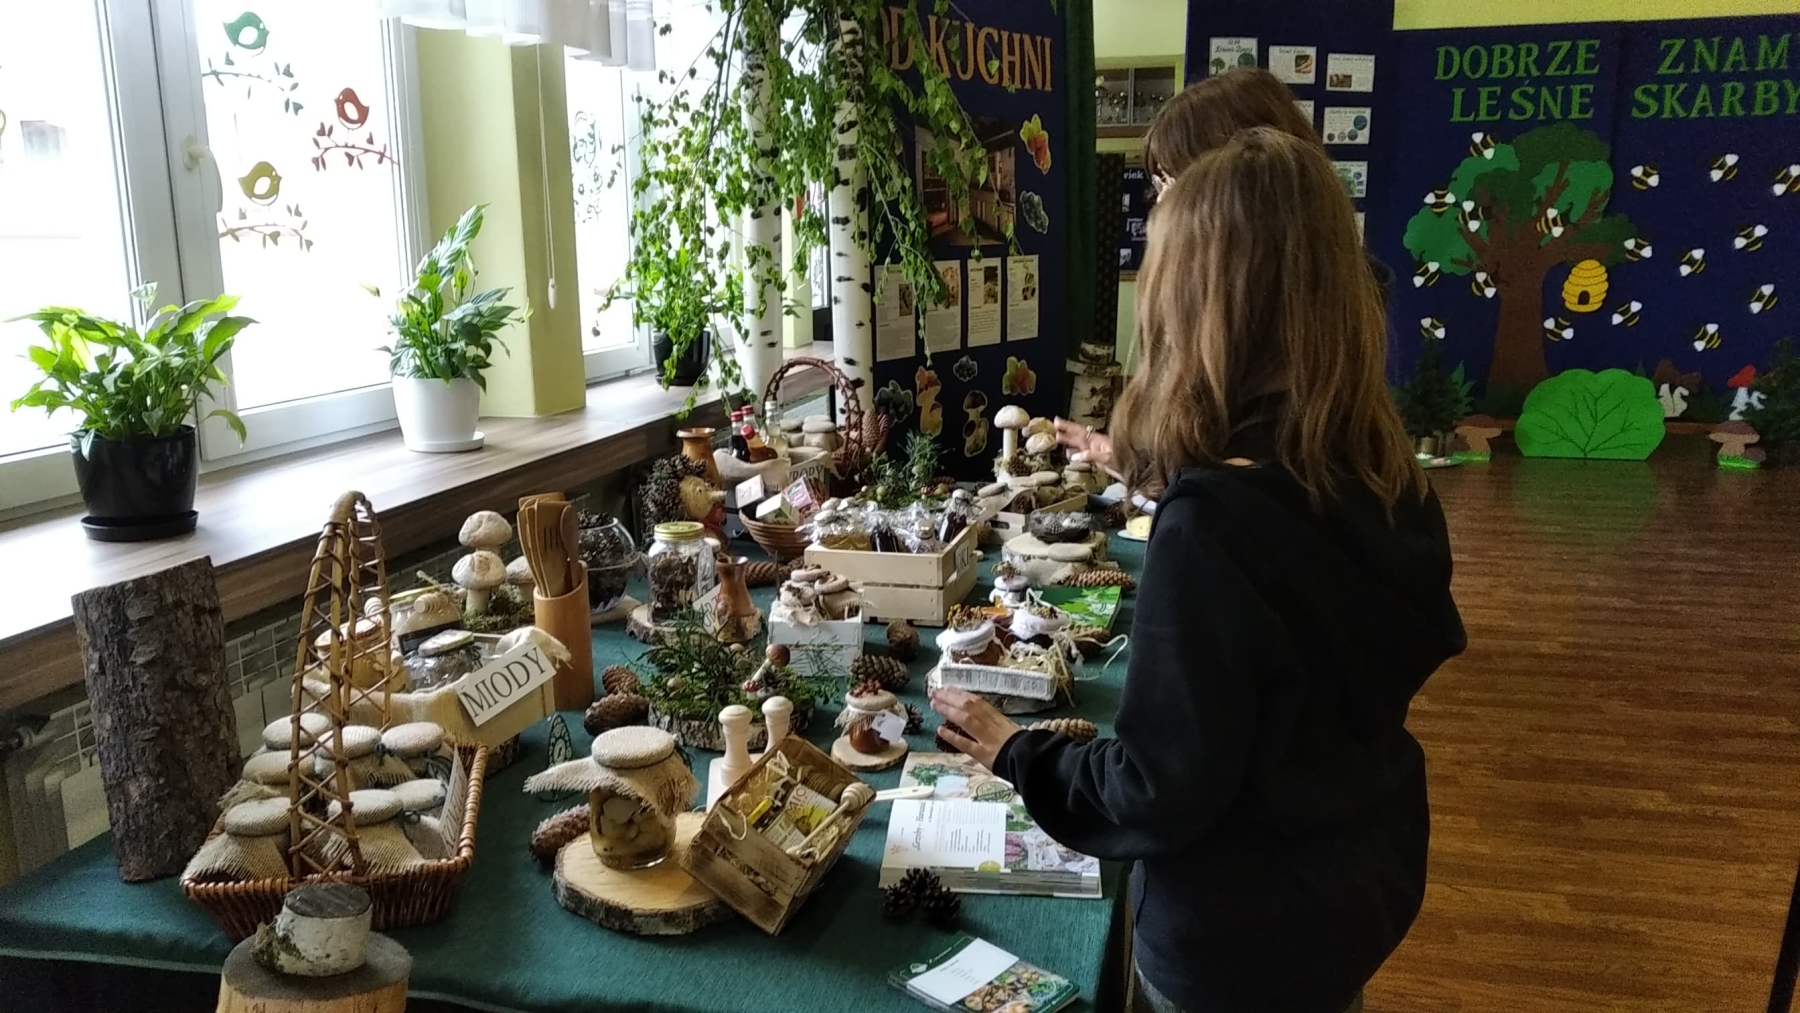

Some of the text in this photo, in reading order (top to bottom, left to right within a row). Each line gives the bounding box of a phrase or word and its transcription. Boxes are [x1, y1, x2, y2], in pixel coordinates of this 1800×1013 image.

[927, 14, 1052, 91] KUCHNI
[1434, 32, 1800, 80] DOBRZE ZNAM
[1450, 78, 1800, 122] LEŚNE SKARBY
[460, 647, 546, 718] MIODY
